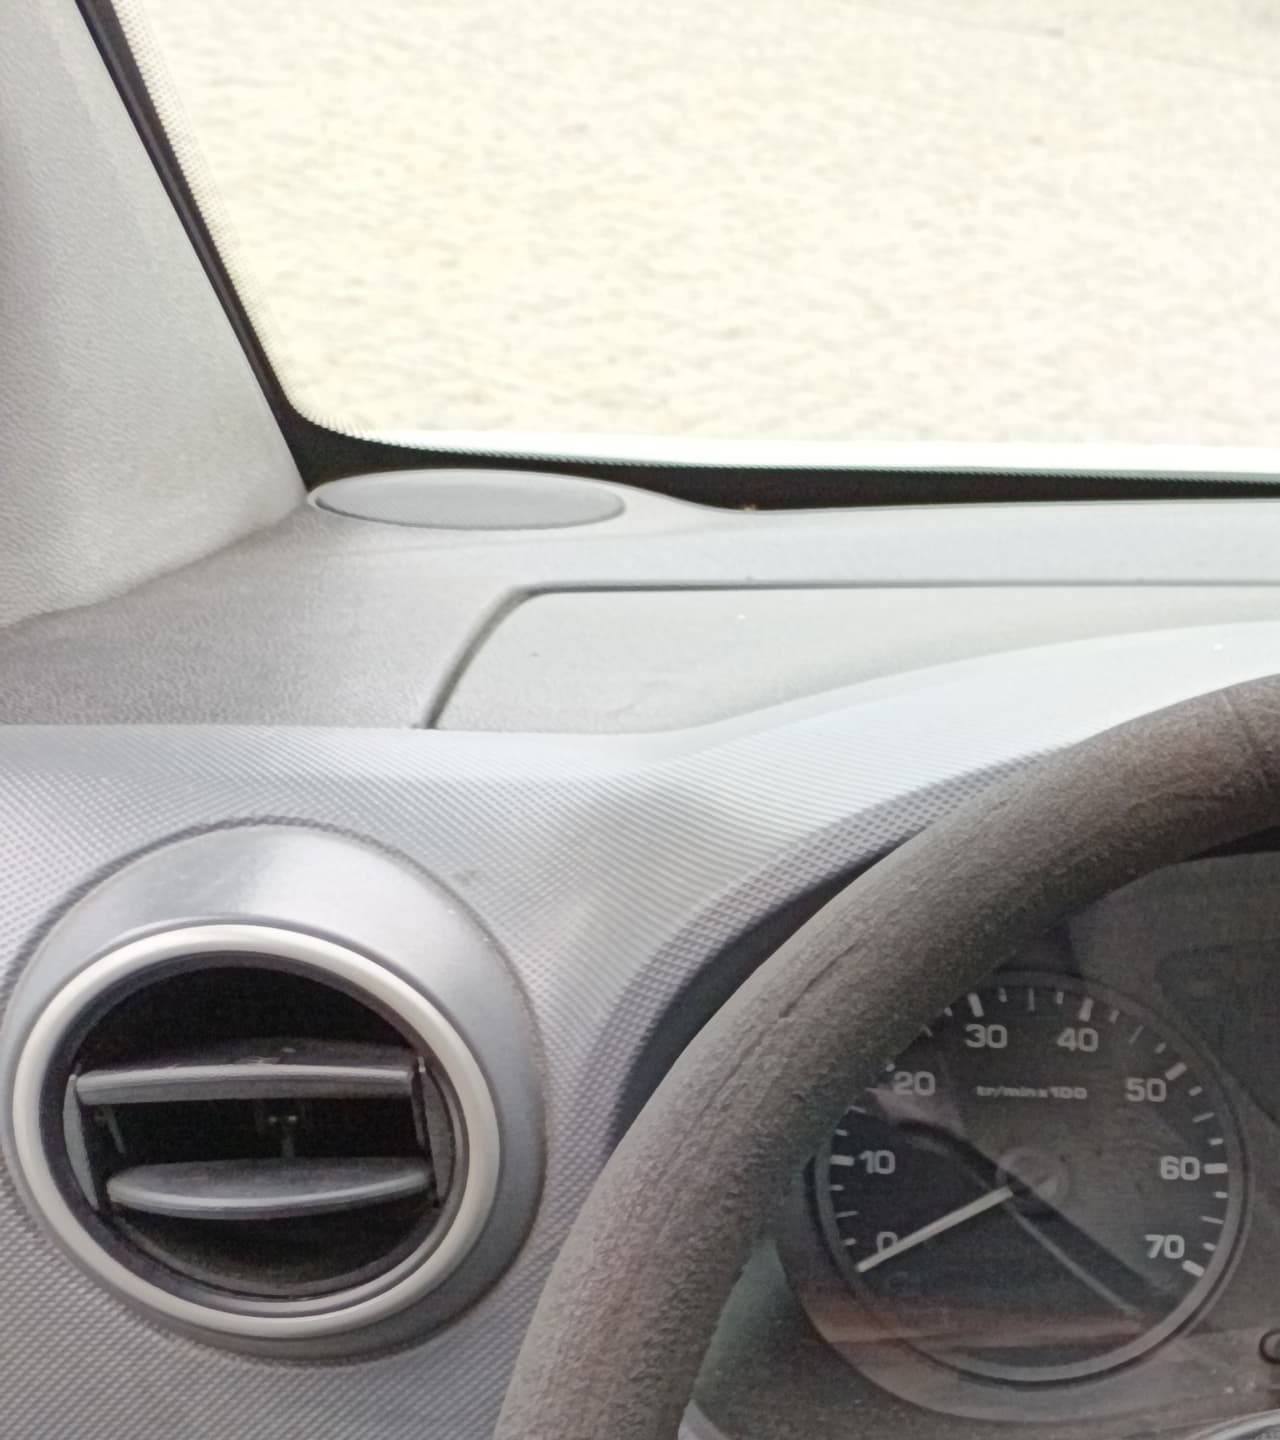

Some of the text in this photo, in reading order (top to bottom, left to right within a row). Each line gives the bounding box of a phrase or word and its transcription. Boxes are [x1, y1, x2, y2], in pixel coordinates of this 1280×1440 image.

[964, 1023, 1008, 1049] 30
[1057, 1027, 1099, 1052] 40
[893, 1070, 936, 1097] 20
[1125, 1077, 1168, 1103] 50
[859, 1150, 896, 1175] 10
[1160, 1156, 1201, 1181] 60
[1144, 1234, 1185, 1260] 70
